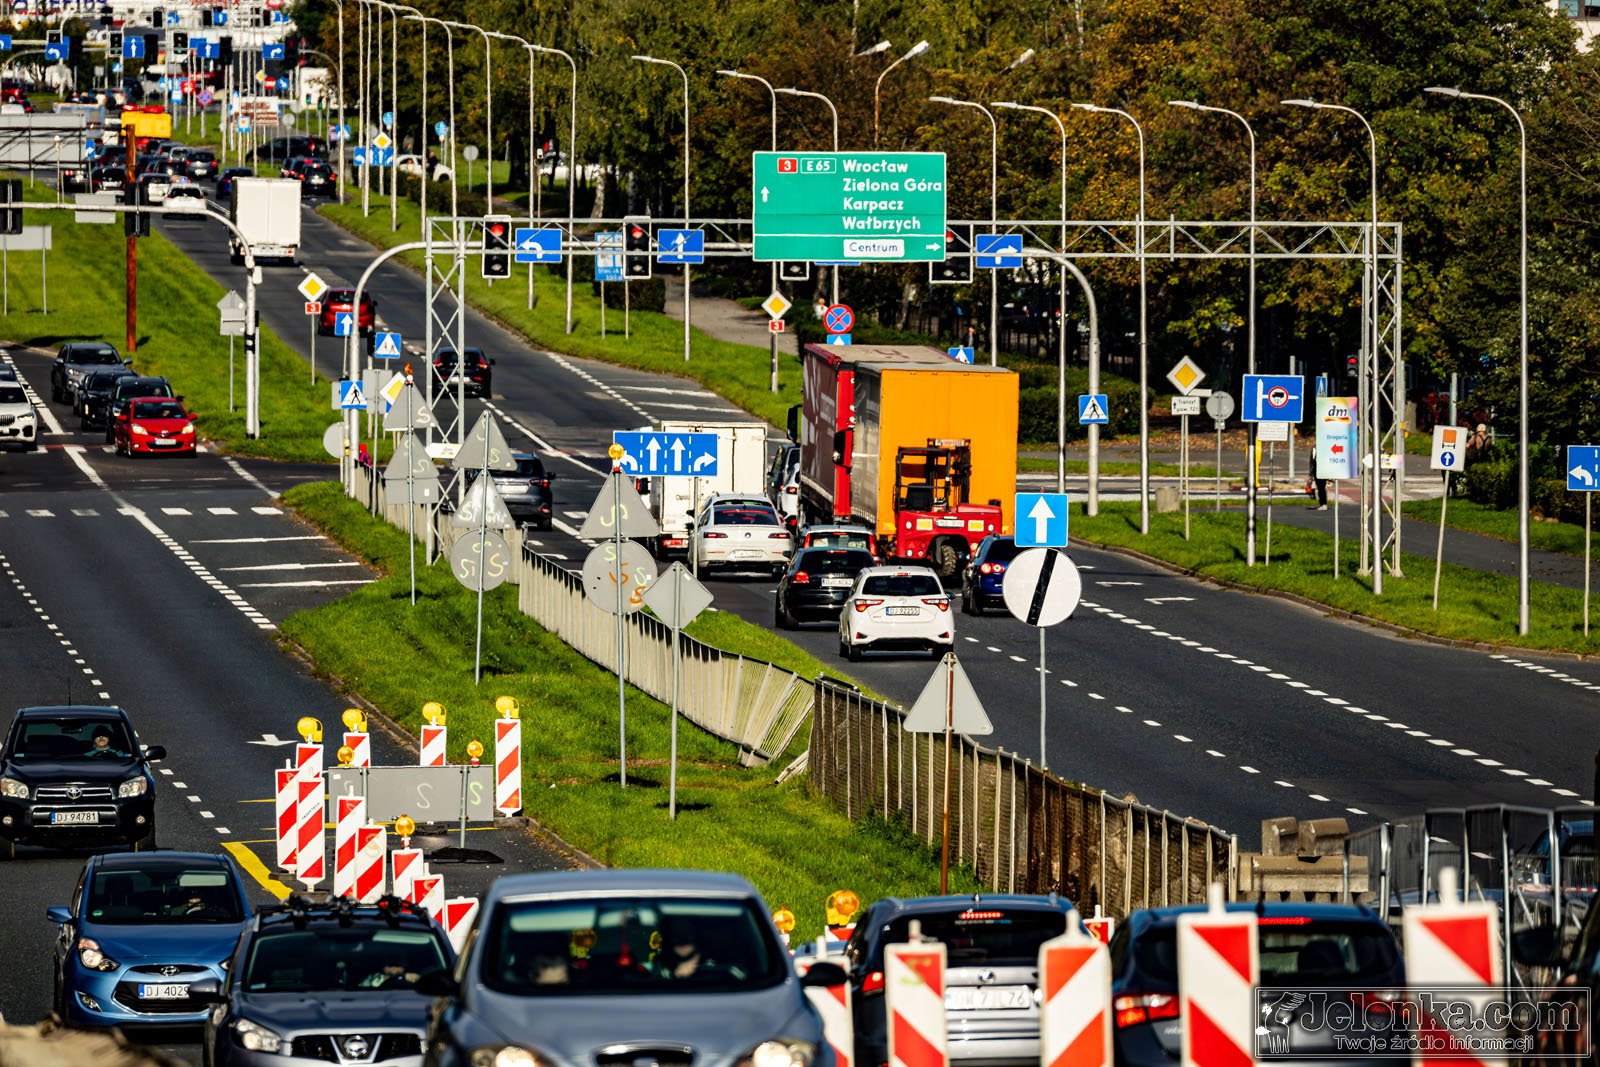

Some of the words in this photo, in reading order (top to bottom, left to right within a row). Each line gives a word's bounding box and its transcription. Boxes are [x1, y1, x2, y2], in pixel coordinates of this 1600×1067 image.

[783, 160, 792, 171] 3
[806, 160, 813, 171] E
[815, 160, 831, 171] 65
[842, 159, 909, 173] Wrocław
[842, 178, 899, 192] Zielona
[903, 178, 942, 192] Góra
[843, 197, 904, 214] Karpacz
[842, 216, 921, 233] Wałbrzych
[849, 242, 898, 253] Centrum
[310, 303, 316, 312] 3
[774, 322, 780, 331] 3
[1328, 405, 1347, 417] dm
[416, 782, 433, 809] S
[469, 781, 484, 805] S
[56, 812, 68, 823] DJ
[69, 812, 96, 823] 94781
[146, 984, 160, 996] DJ
[163, 984, 189, 996] 4029
